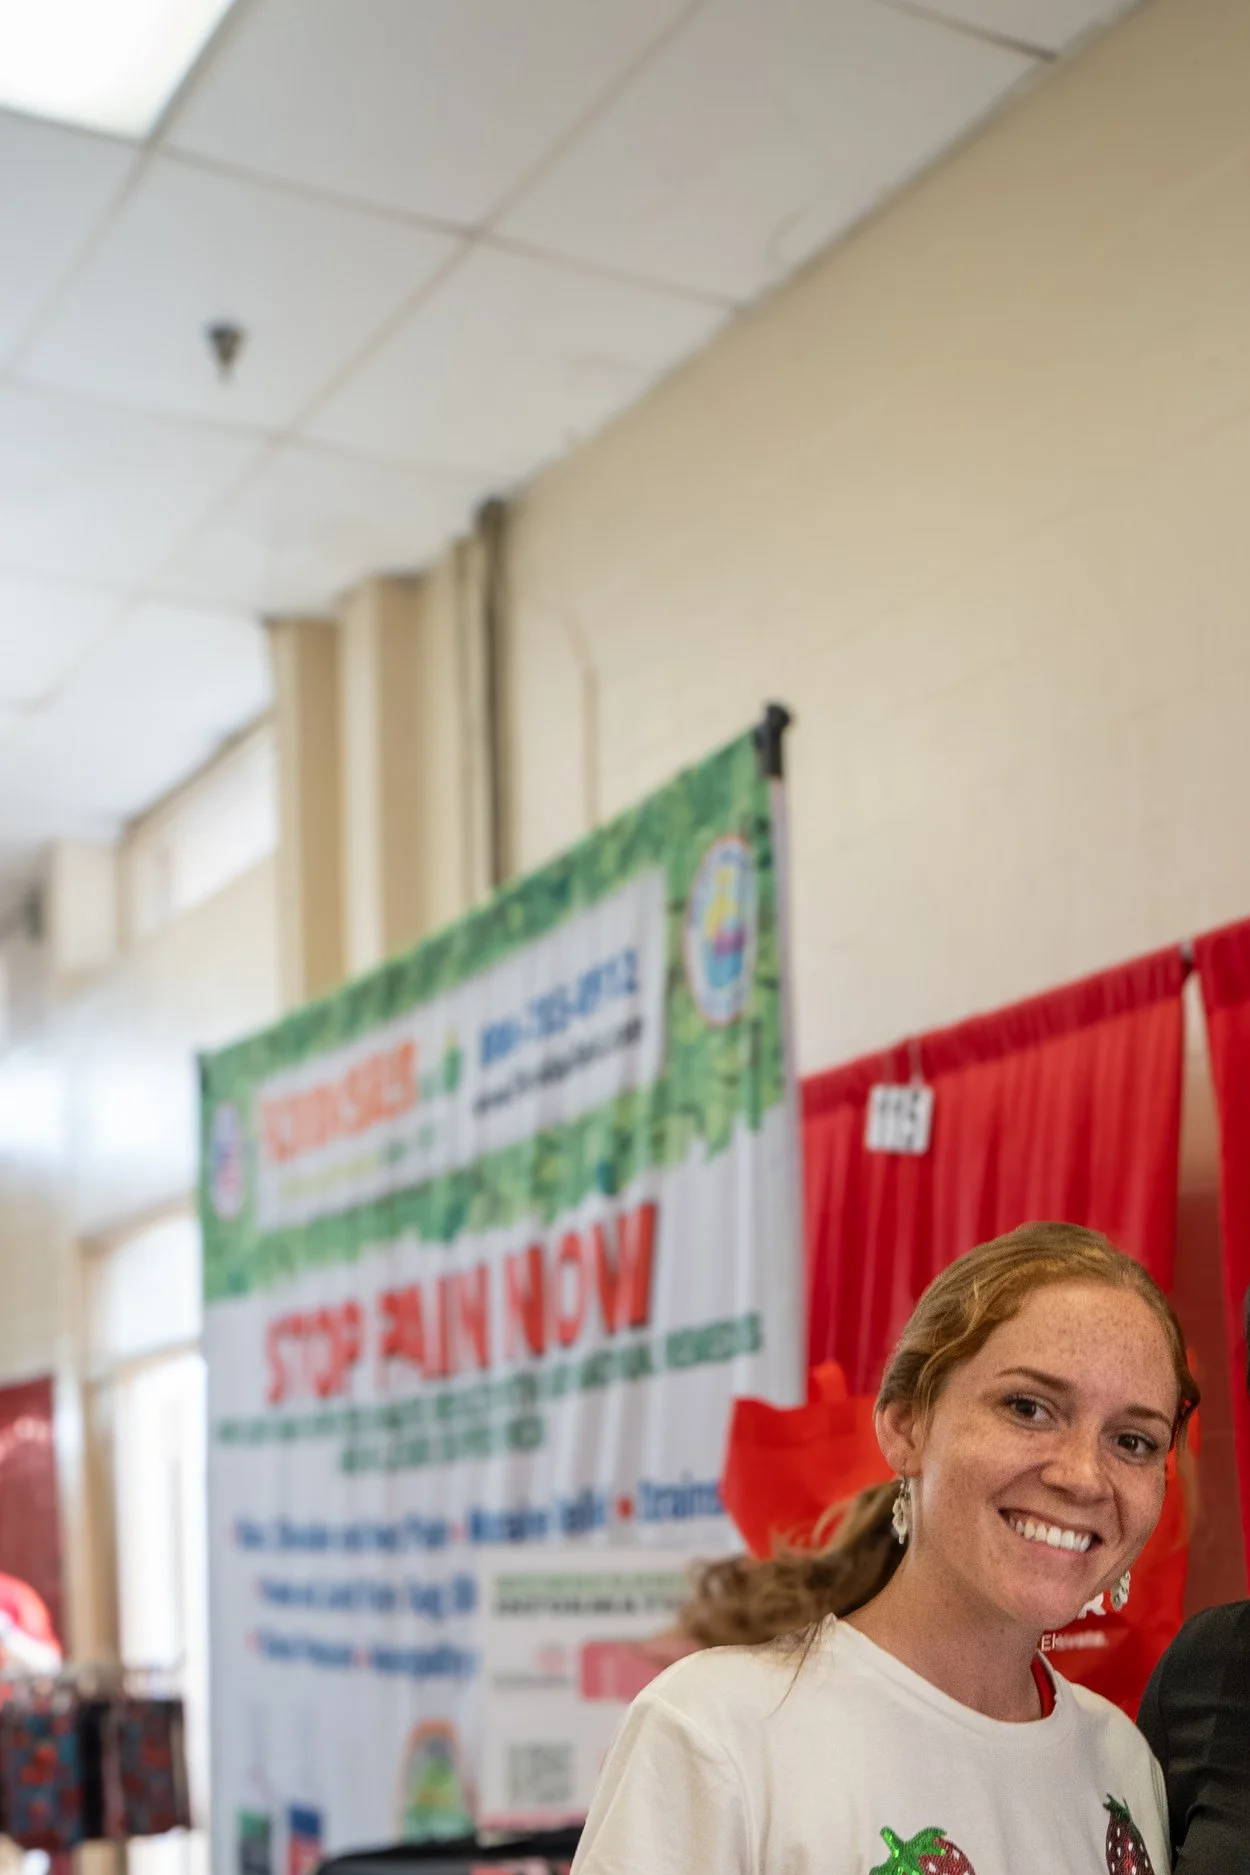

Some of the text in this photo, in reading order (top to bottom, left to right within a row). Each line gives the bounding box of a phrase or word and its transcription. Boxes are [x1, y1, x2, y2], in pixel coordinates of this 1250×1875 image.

[266, 1298, 362, 1404] STOP
[374, 1260, 490, 1388] PAIN
[504, 1198, 658, 1358] NOW
